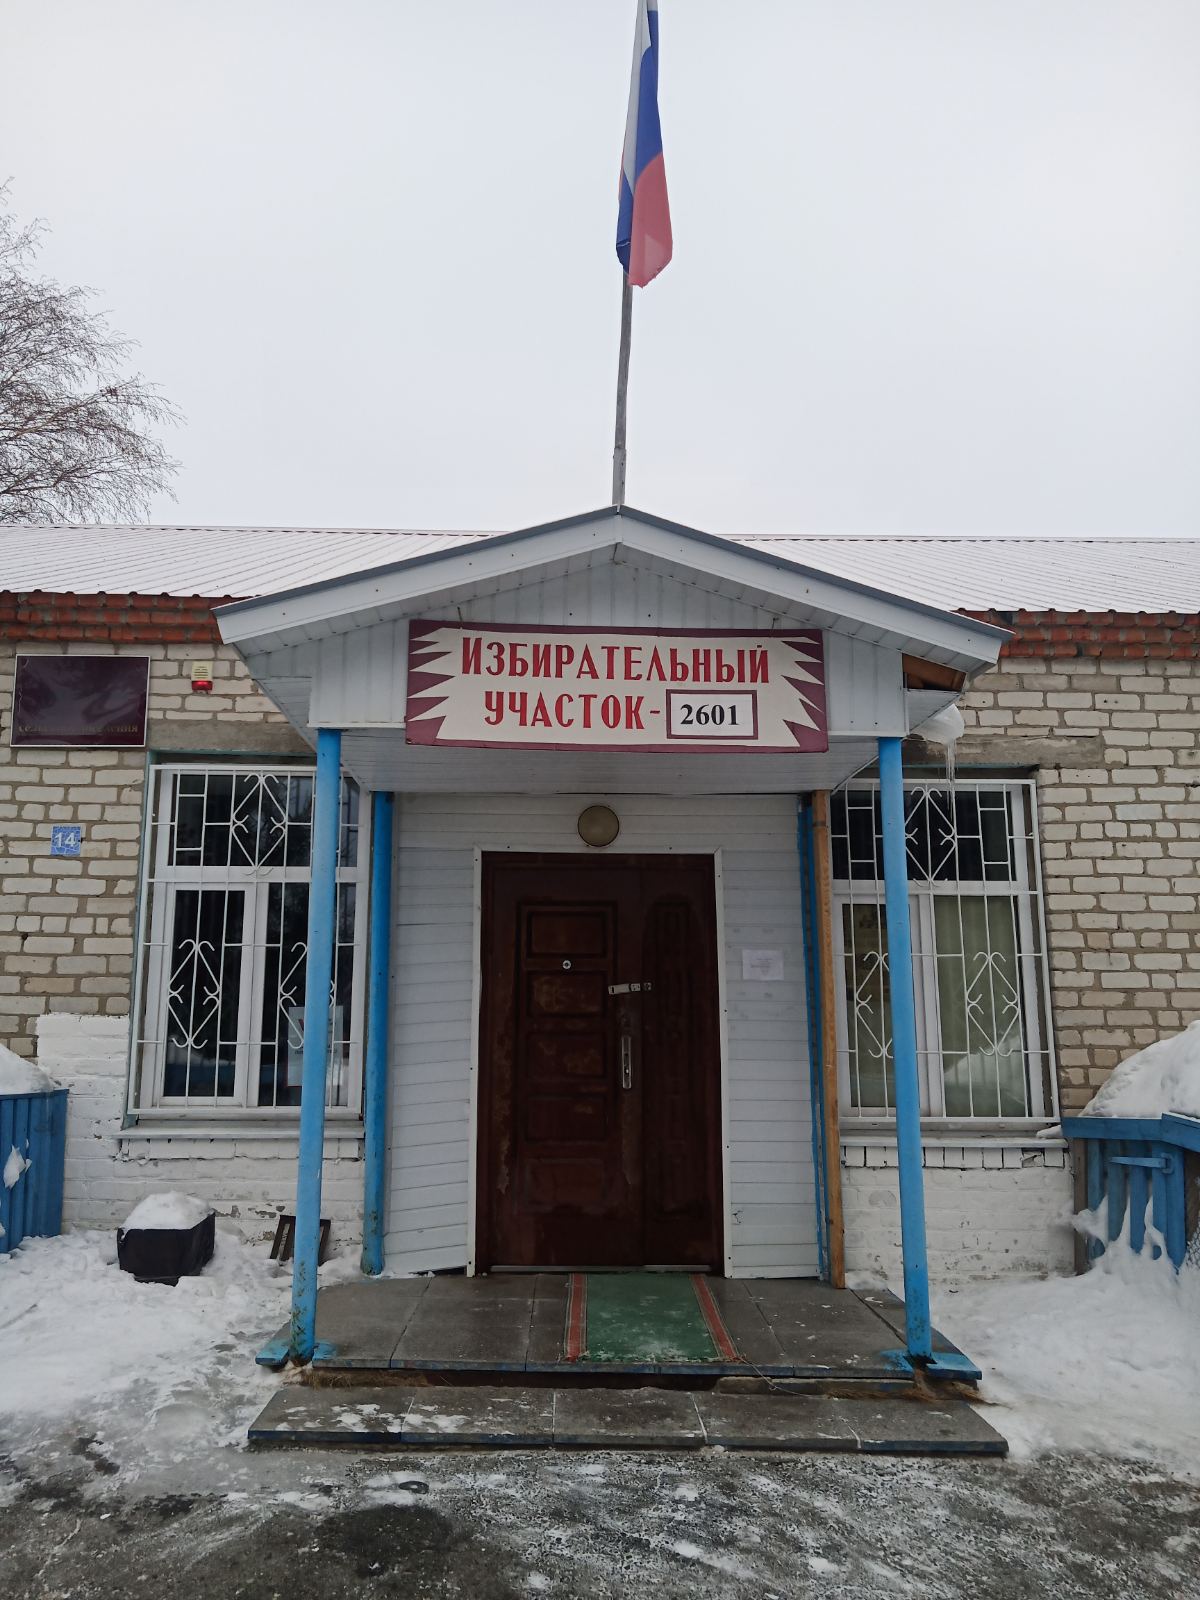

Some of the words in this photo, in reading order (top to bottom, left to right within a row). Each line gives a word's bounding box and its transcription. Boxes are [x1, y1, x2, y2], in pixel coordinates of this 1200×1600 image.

[461, 636, 770, 684] ИЗБИРАТЕЛЬНЫЙ
[680, 702, 740, 726] 2601
[54, 832, 76, 848] 14
